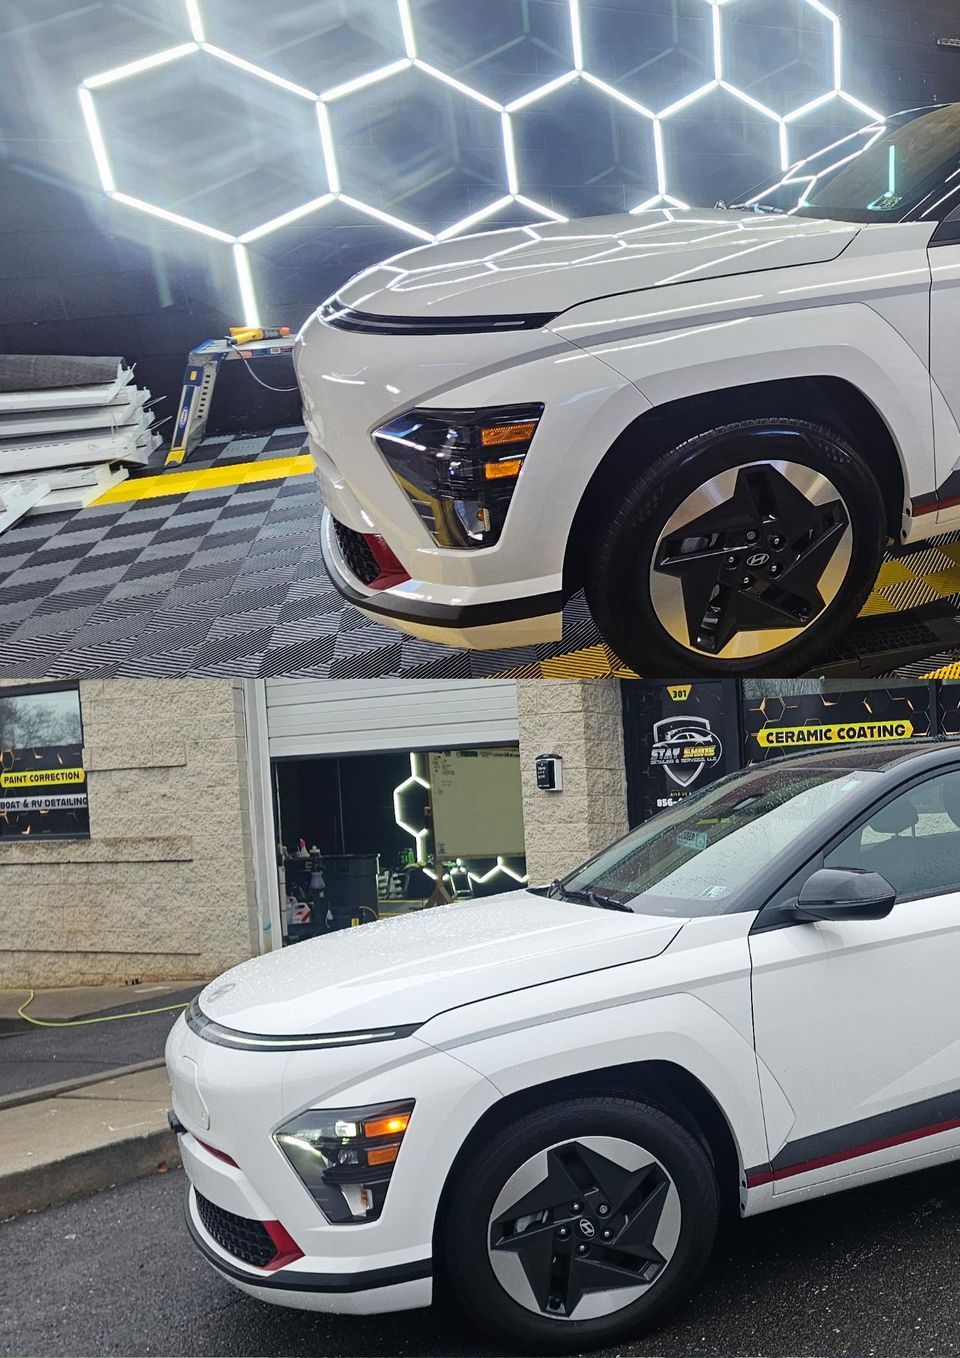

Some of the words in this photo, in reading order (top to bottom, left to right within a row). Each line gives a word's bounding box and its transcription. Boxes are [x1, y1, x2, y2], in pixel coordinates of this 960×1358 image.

[672, 690, 687, 698] 301
[765, 728, 832, 744] CERAMIC
[836, 723, 906, 741] COATING
[651, 748, 680, 760] STAY
[4, 775, 27, 784] PAINT
[29, 771, 80, 783] CORRECTION
[0, 801, 20, 810] BOAT
[23, 799, 29, 808] &
[31, 799, 42, 807] RV
